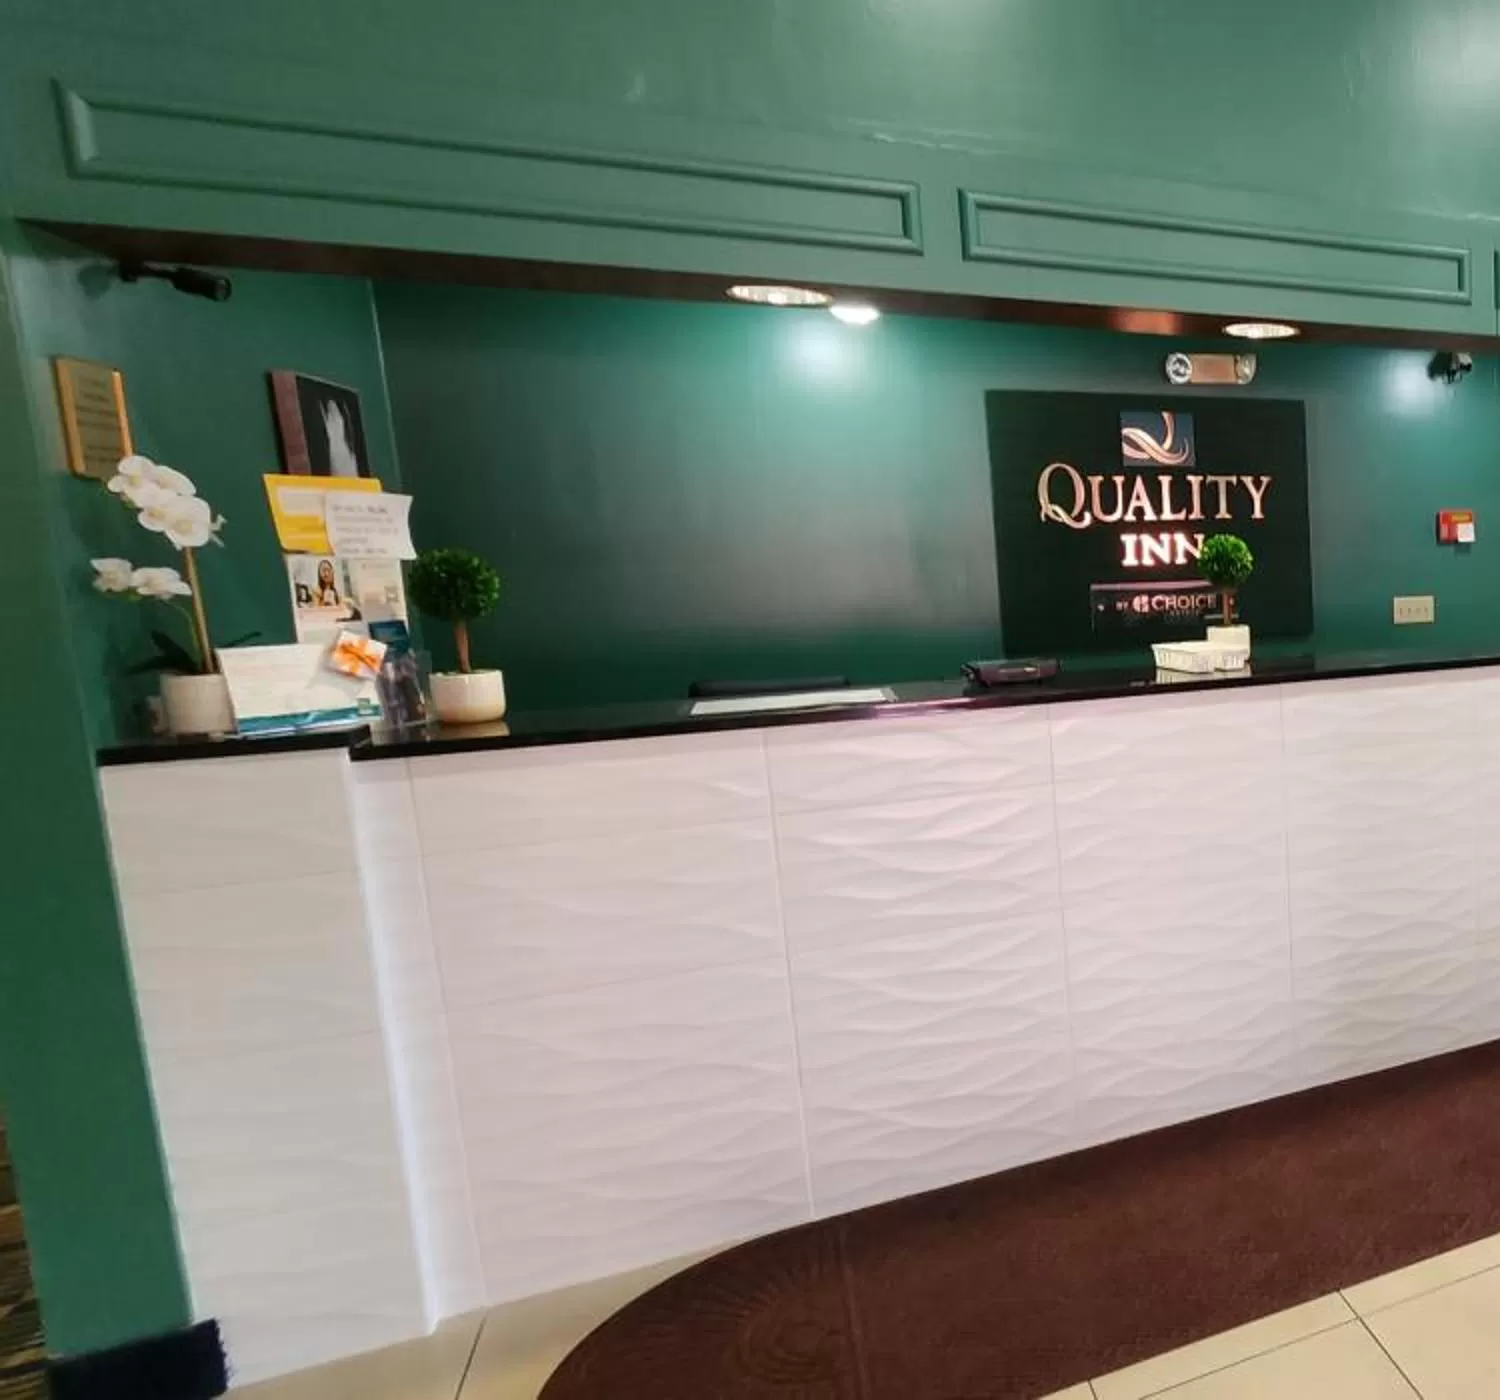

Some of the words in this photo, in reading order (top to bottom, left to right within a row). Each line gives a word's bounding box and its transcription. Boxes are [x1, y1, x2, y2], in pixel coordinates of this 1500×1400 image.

[1037, 462, 1272, 529] QUALITY
[1120, 533, 1205, 567] INN
[1151, 592, 1217, 611] CHOICE
